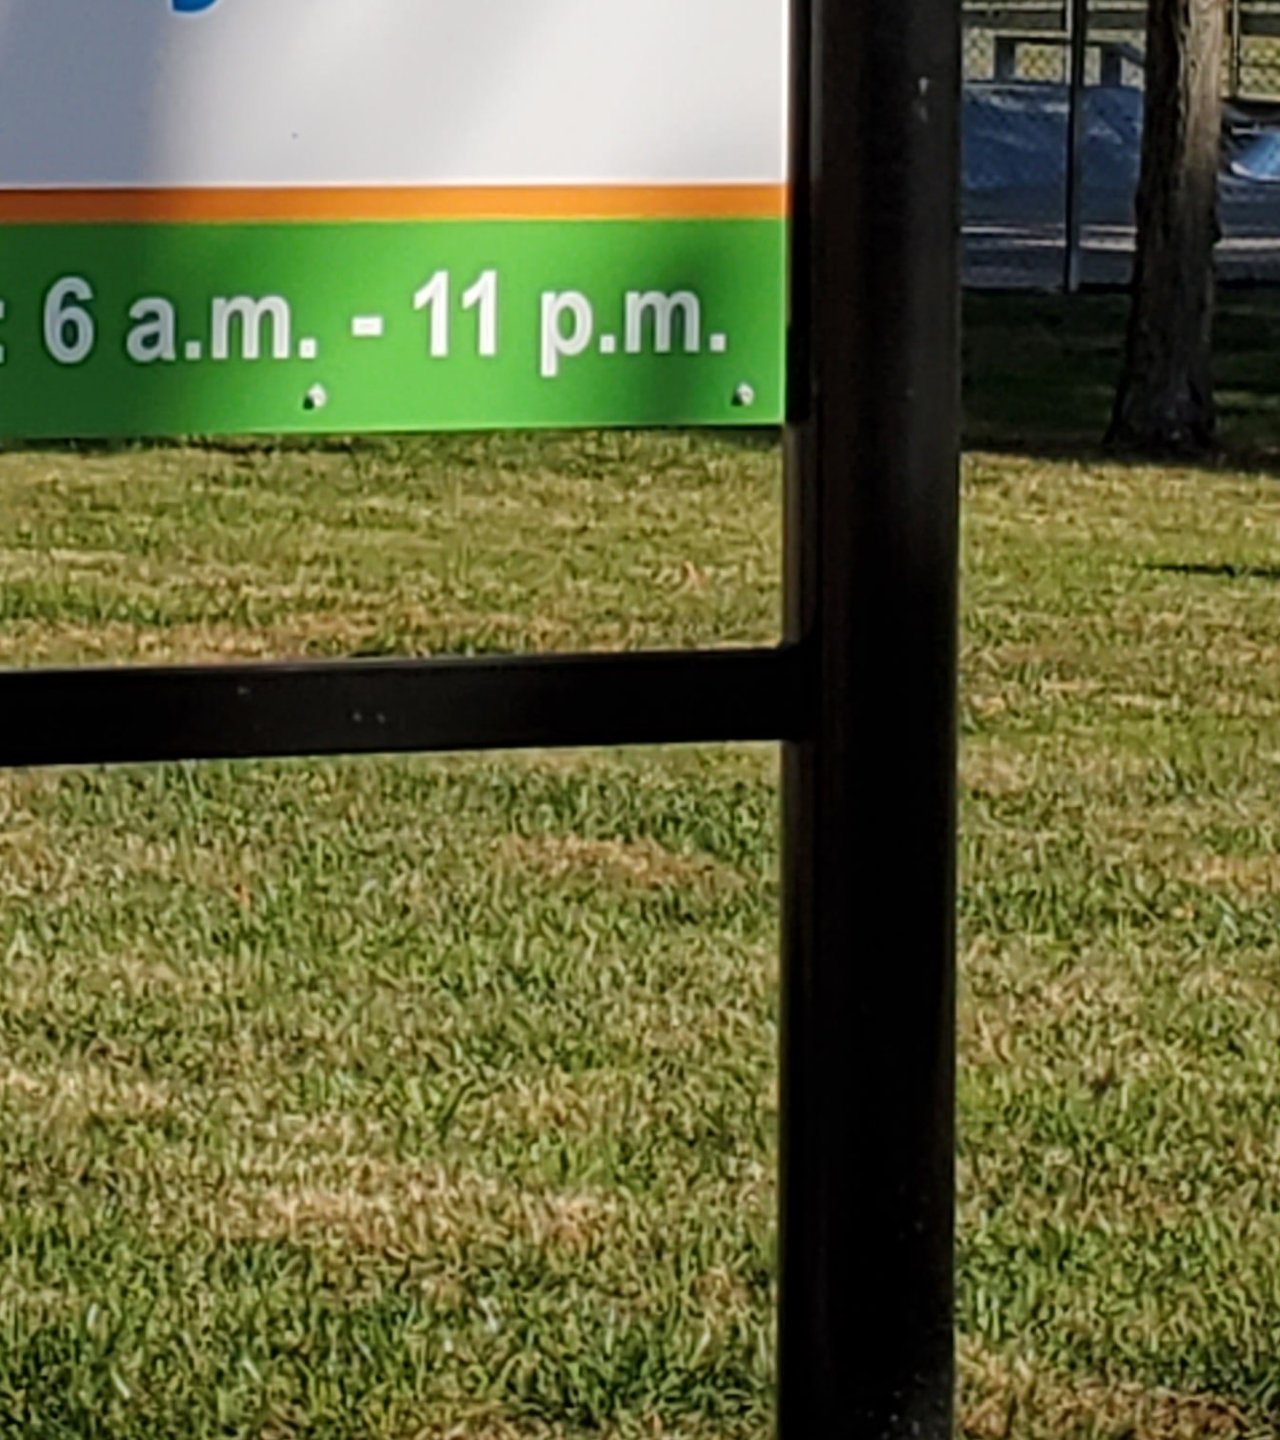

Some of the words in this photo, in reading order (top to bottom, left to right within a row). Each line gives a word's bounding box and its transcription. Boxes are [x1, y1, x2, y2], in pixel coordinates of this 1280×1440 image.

[43, 276, 95, 364] 6
[126, 293, 317, 361] a.m.
[353, 317, 381, 334] -
[412, 271, 500, 358] 11
[539, 286, 727, 377] p.m.
